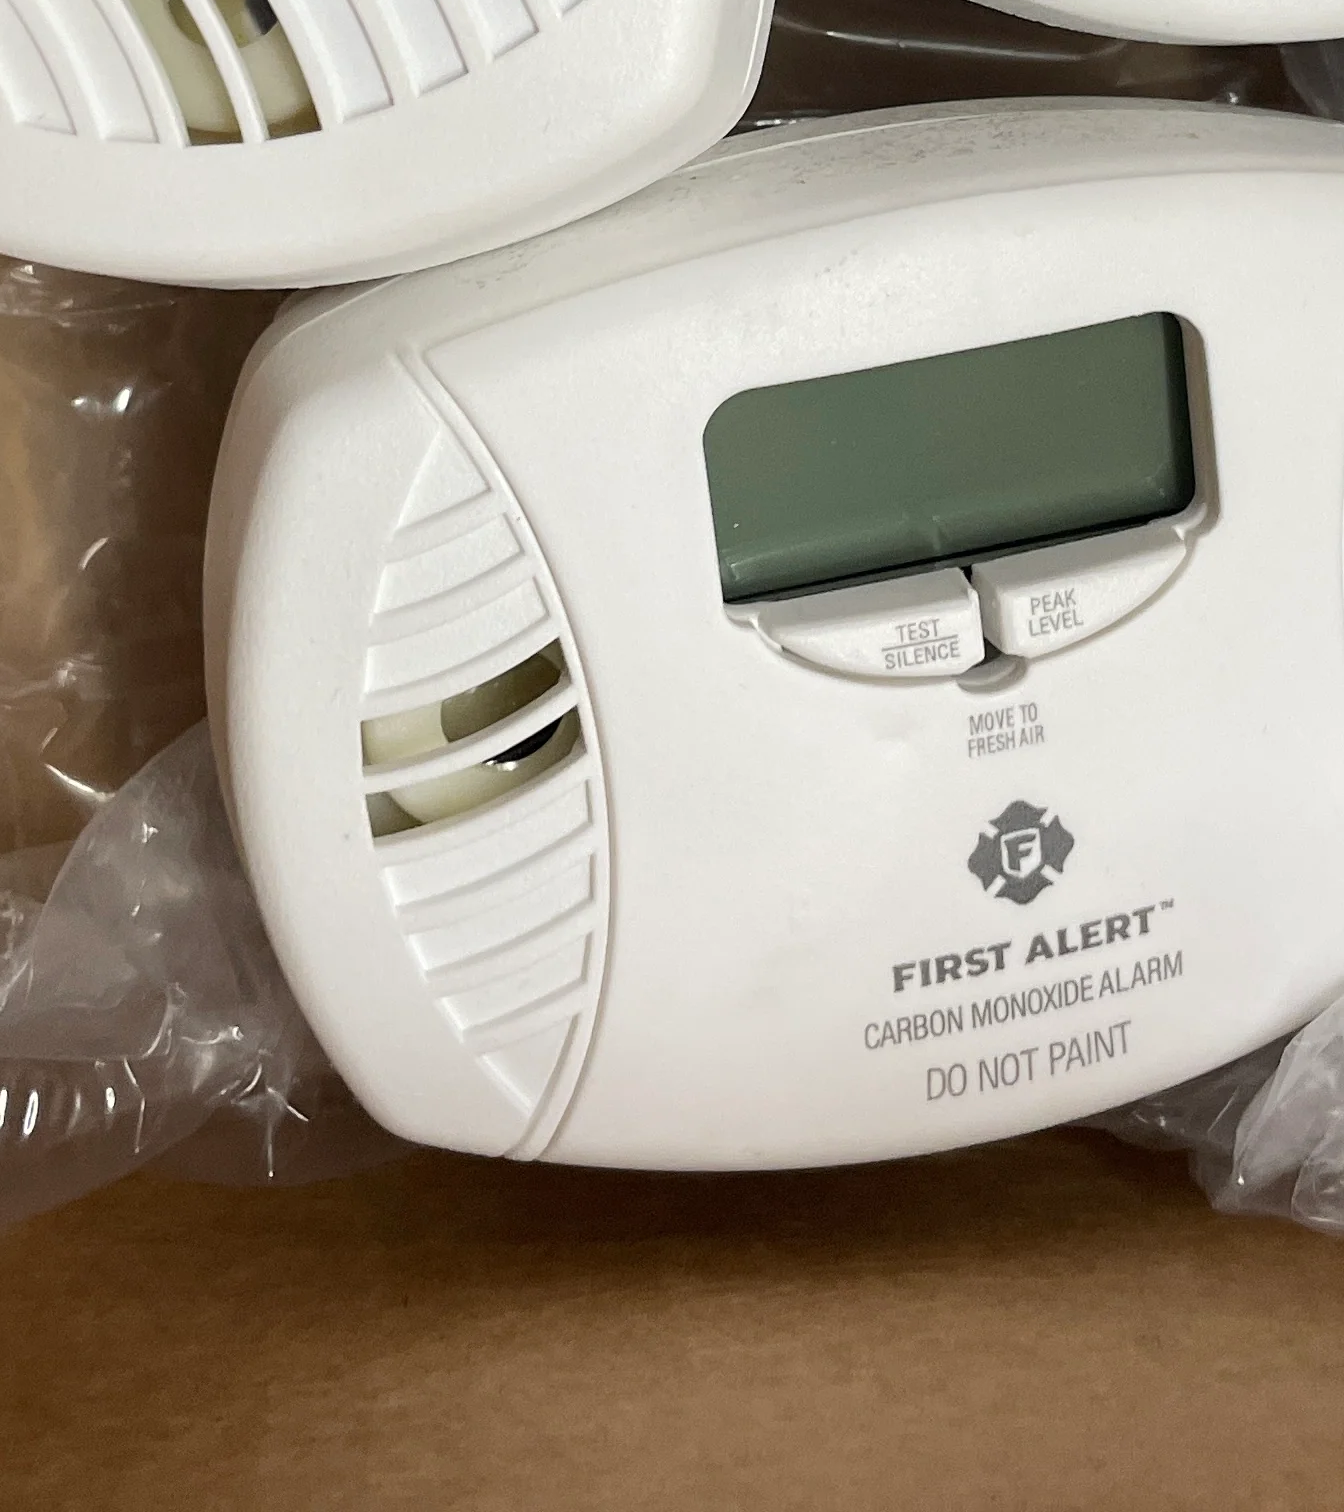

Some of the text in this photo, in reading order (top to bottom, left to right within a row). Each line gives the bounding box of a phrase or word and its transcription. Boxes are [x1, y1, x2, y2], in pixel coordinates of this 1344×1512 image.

[1030, 589, 1077, 615] PEAK
[895, 619, 939, 643] TEST
[1028, 607, 1084, 637] LEVEL
[884, 639, 961, 670] SILENCE
[969, 702, 1038, 736] MOVE TO
[968, 724, 1045, 758] FRESH AIR
[892, 939, 1012, 993] FIRST
[864, 950, 1184, 1050] CARBON MONOXIDE ALARM
[926, 1020, 1132, 1101] DO NOT PAINT
